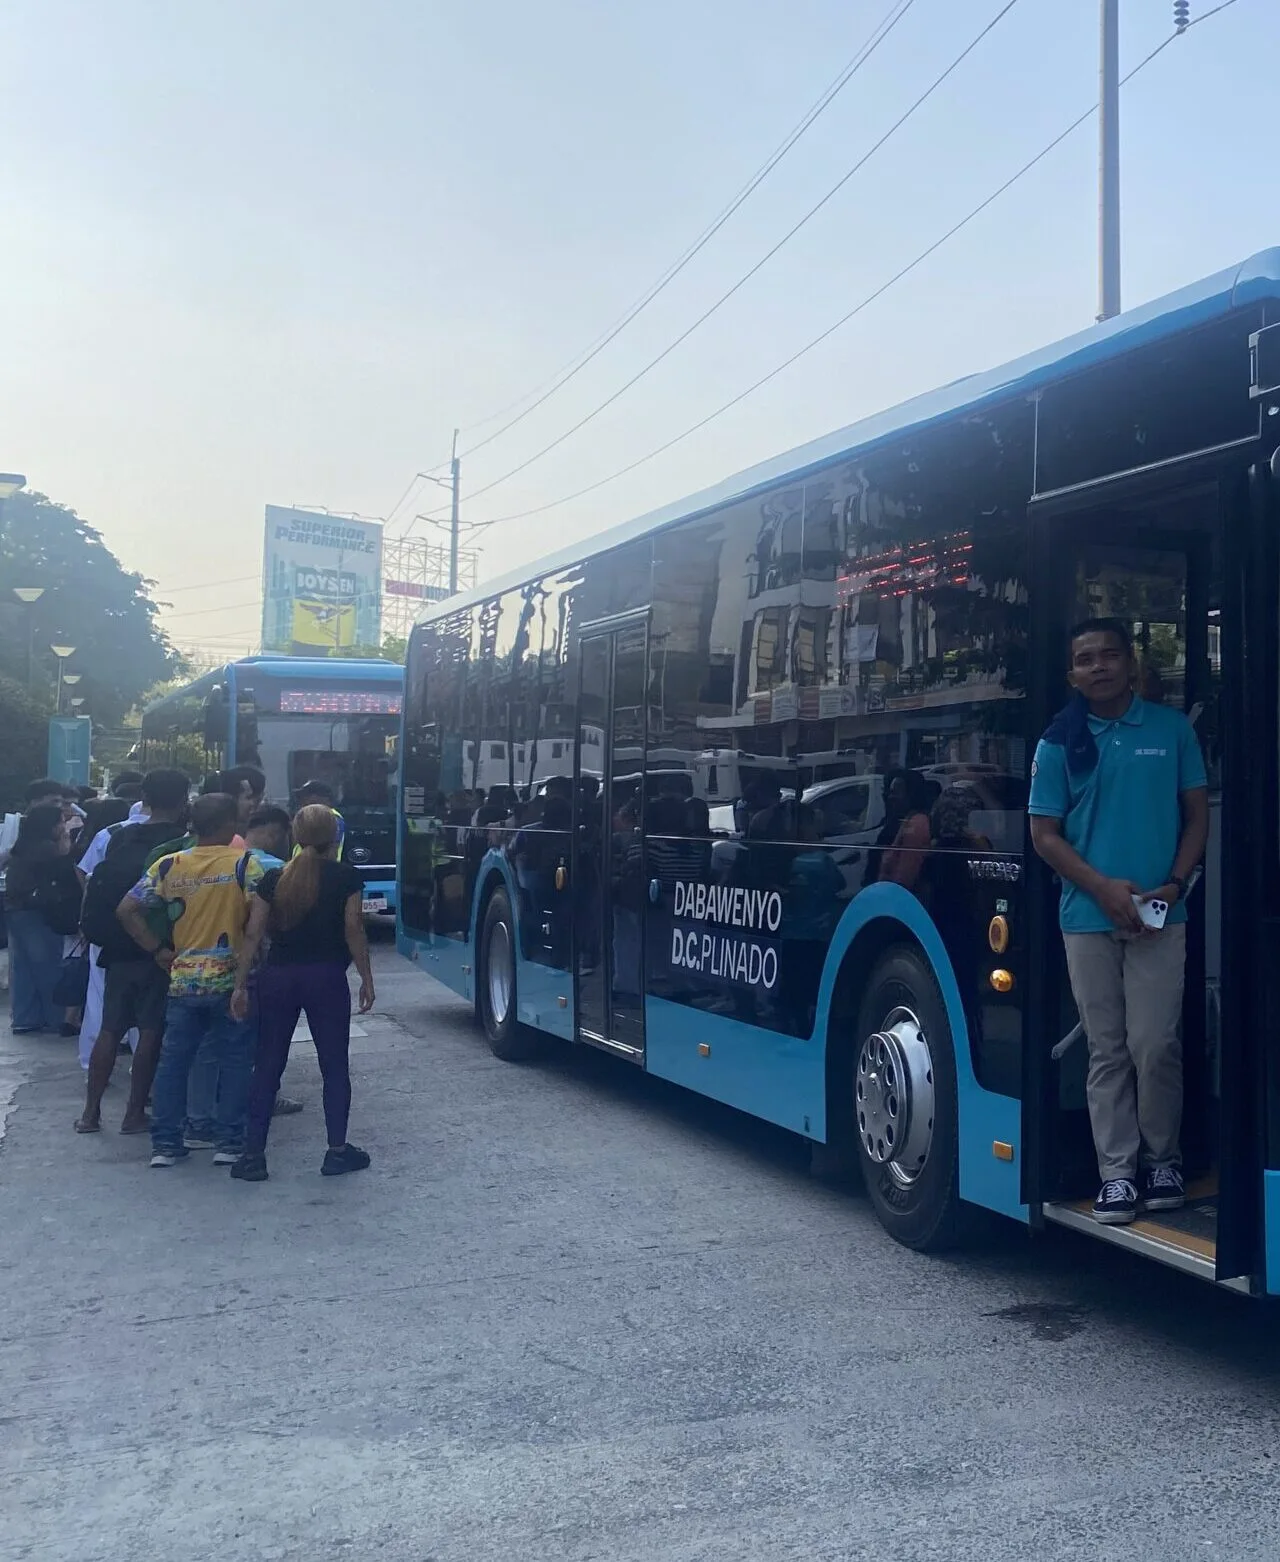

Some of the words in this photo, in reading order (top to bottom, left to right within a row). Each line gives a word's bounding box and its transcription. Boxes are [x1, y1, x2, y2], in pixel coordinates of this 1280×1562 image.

[274, 525, 377, 554] PERFORMANCE
[290, 519, 367, 541] SUPERIOR
[297, 572, 355, 594] BOYSEN
[674, 881, 782, 931] DABAWENYO
